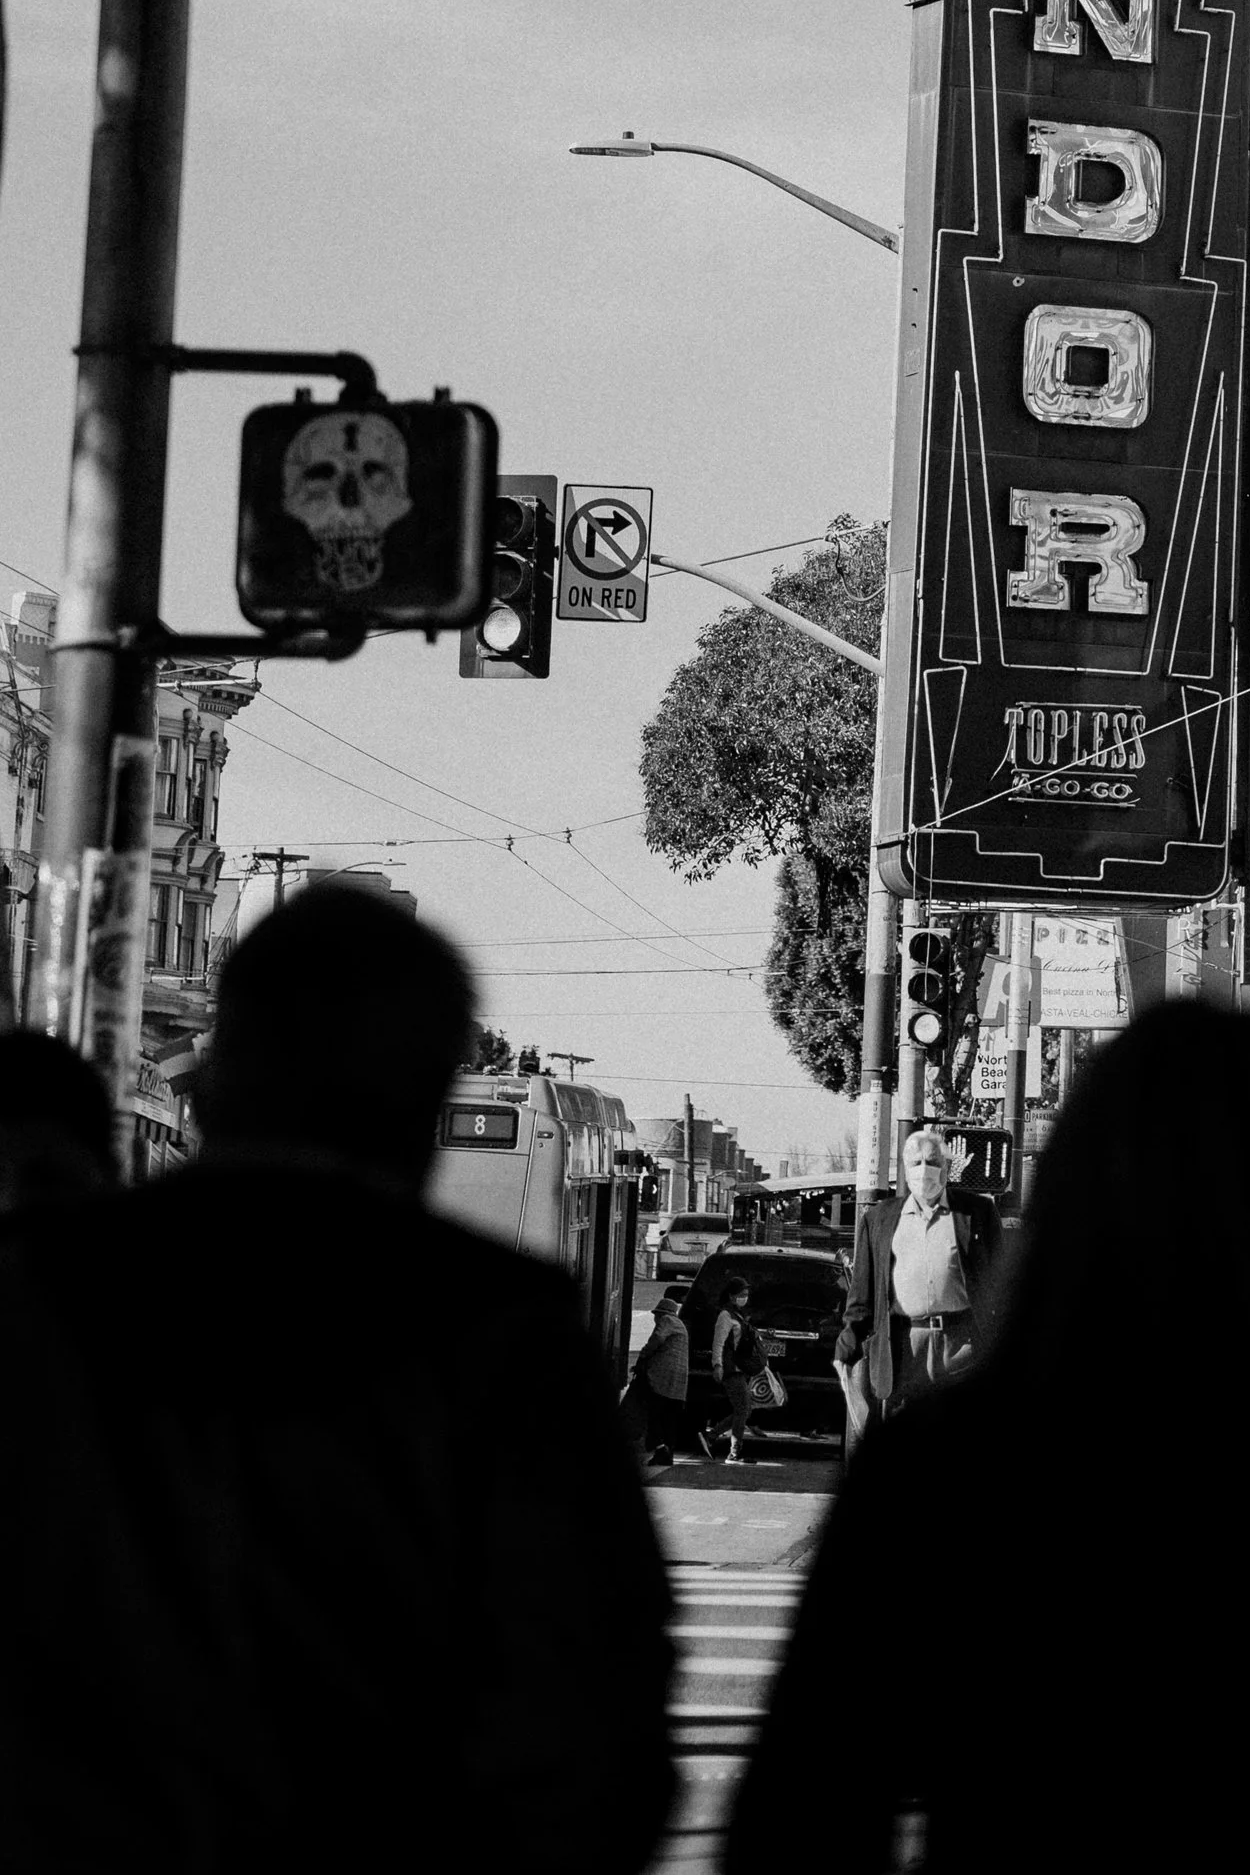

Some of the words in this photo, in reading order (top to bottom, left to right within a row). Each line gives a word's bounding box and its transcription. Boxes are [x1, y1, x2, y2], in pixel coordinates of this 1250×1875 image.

[568, 585, 592, 607] ON
[600, 587, 637, 609] RED
[1004, 708, 1146, 769] TOPLESS
[1037, 927, 1110, 945] PIZZ
[1042, 987, 1061, 995] Best
[1062, 988, 1084, 998] pizza
[1096, 989, 1116, 997] Nort
[978, 1055, 1007, 1065] Nort
[981, 1067, 1007, 1077] Bea
[474, 1114, 486, 1135] 8
[1032, 1111, 1056, 1123] PARKIN
